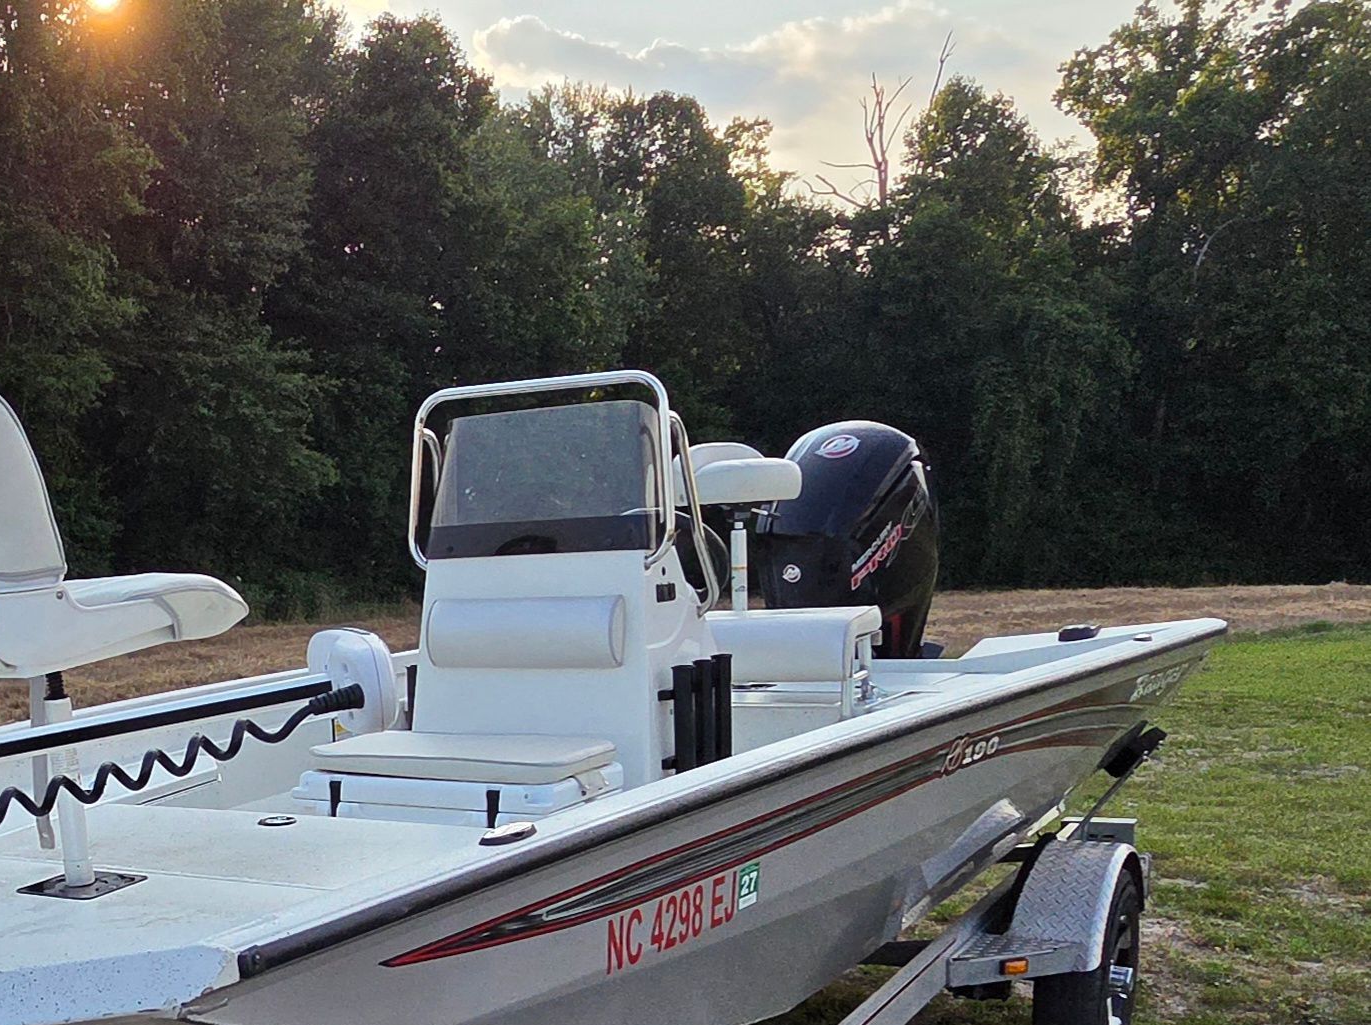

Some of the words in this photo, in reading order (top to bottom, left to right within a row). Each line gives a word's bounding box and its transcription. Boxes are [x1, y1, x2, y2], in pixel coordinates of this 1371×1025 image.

[740, 870, 758, 896] 27
[606, 908, 643, 975] NC
[650, 884, 704, 953] 4298
[710, 870, 737, 929] EJ
